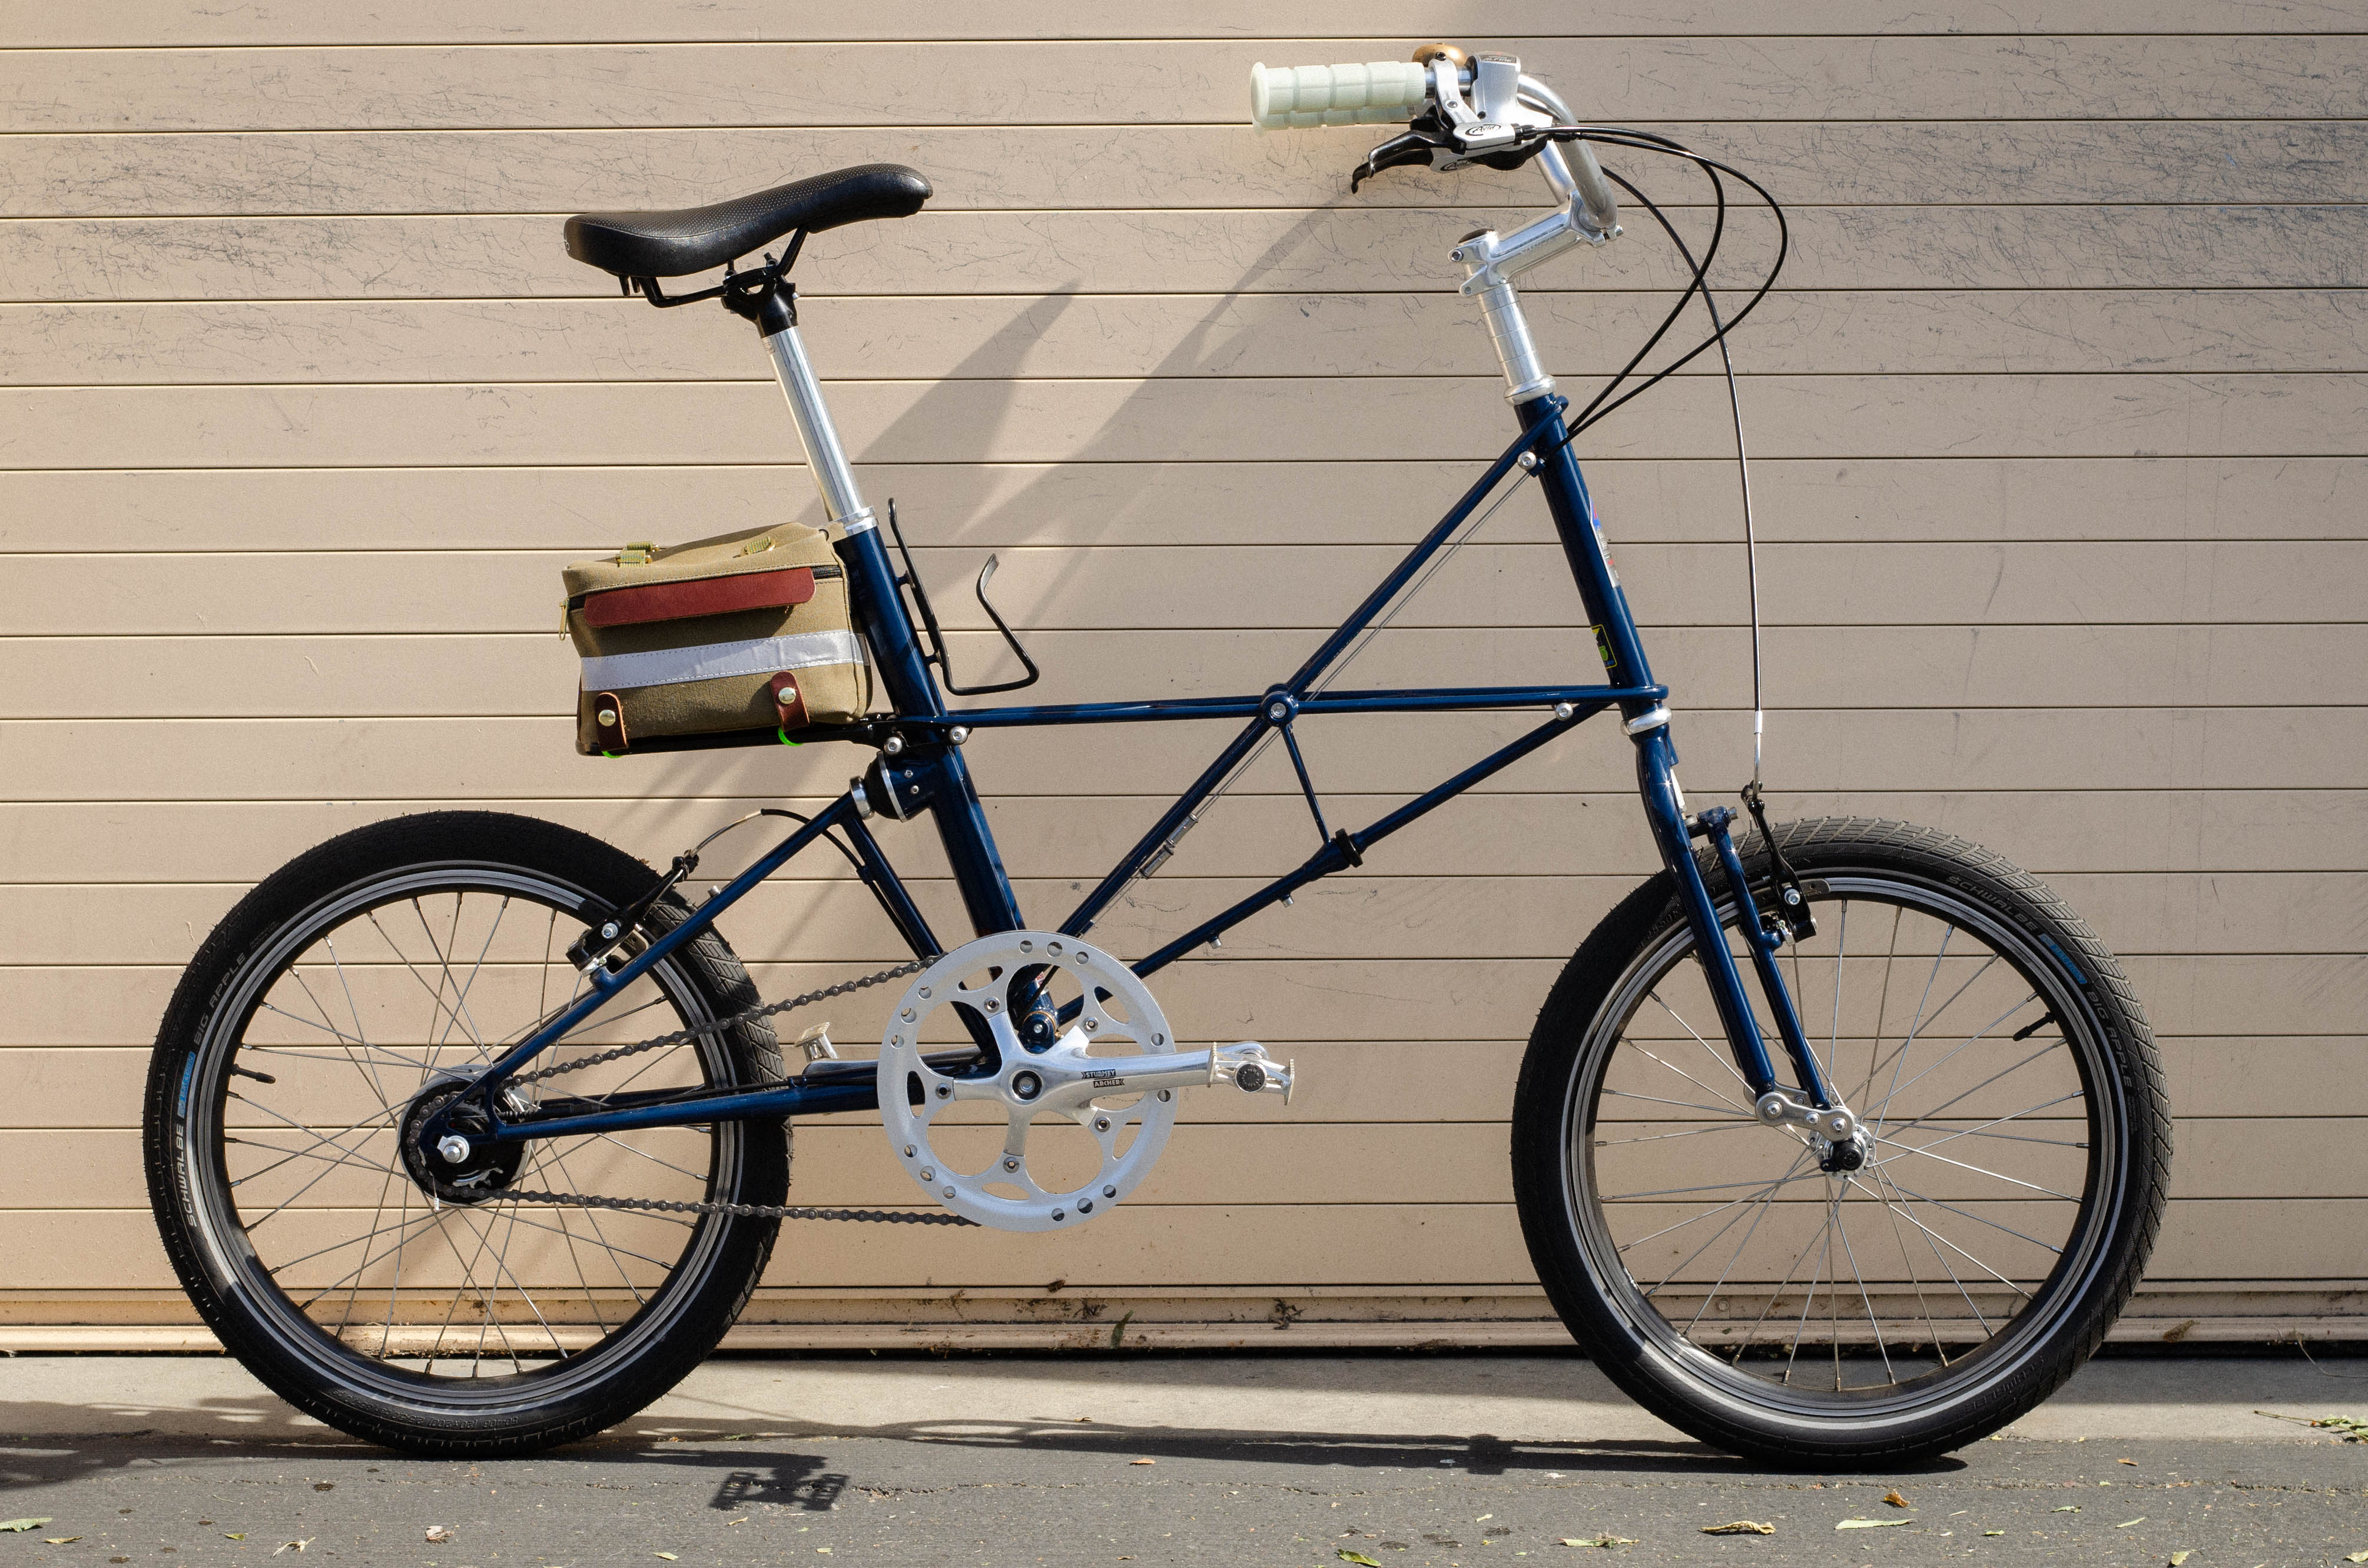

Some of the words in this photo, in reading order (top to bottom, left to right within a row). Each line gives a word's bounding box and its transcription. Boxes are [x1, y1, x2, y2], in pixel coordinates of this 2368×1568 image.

[1470, 124, 1497, 134] Avid
[1947, 875, 2037, 932] SCHWALBE
[193, 1012, 210, 1046] BIG
[208, 952, 247, 1009] APPLE
[1086, 1069, 1115, 1078] STURMEY
[2086, 990, 2109, 1021] BIG
[2106, 1026, 2132, 1088] APPLE
[176, 1124, 197, 1228] SCHWALBE
